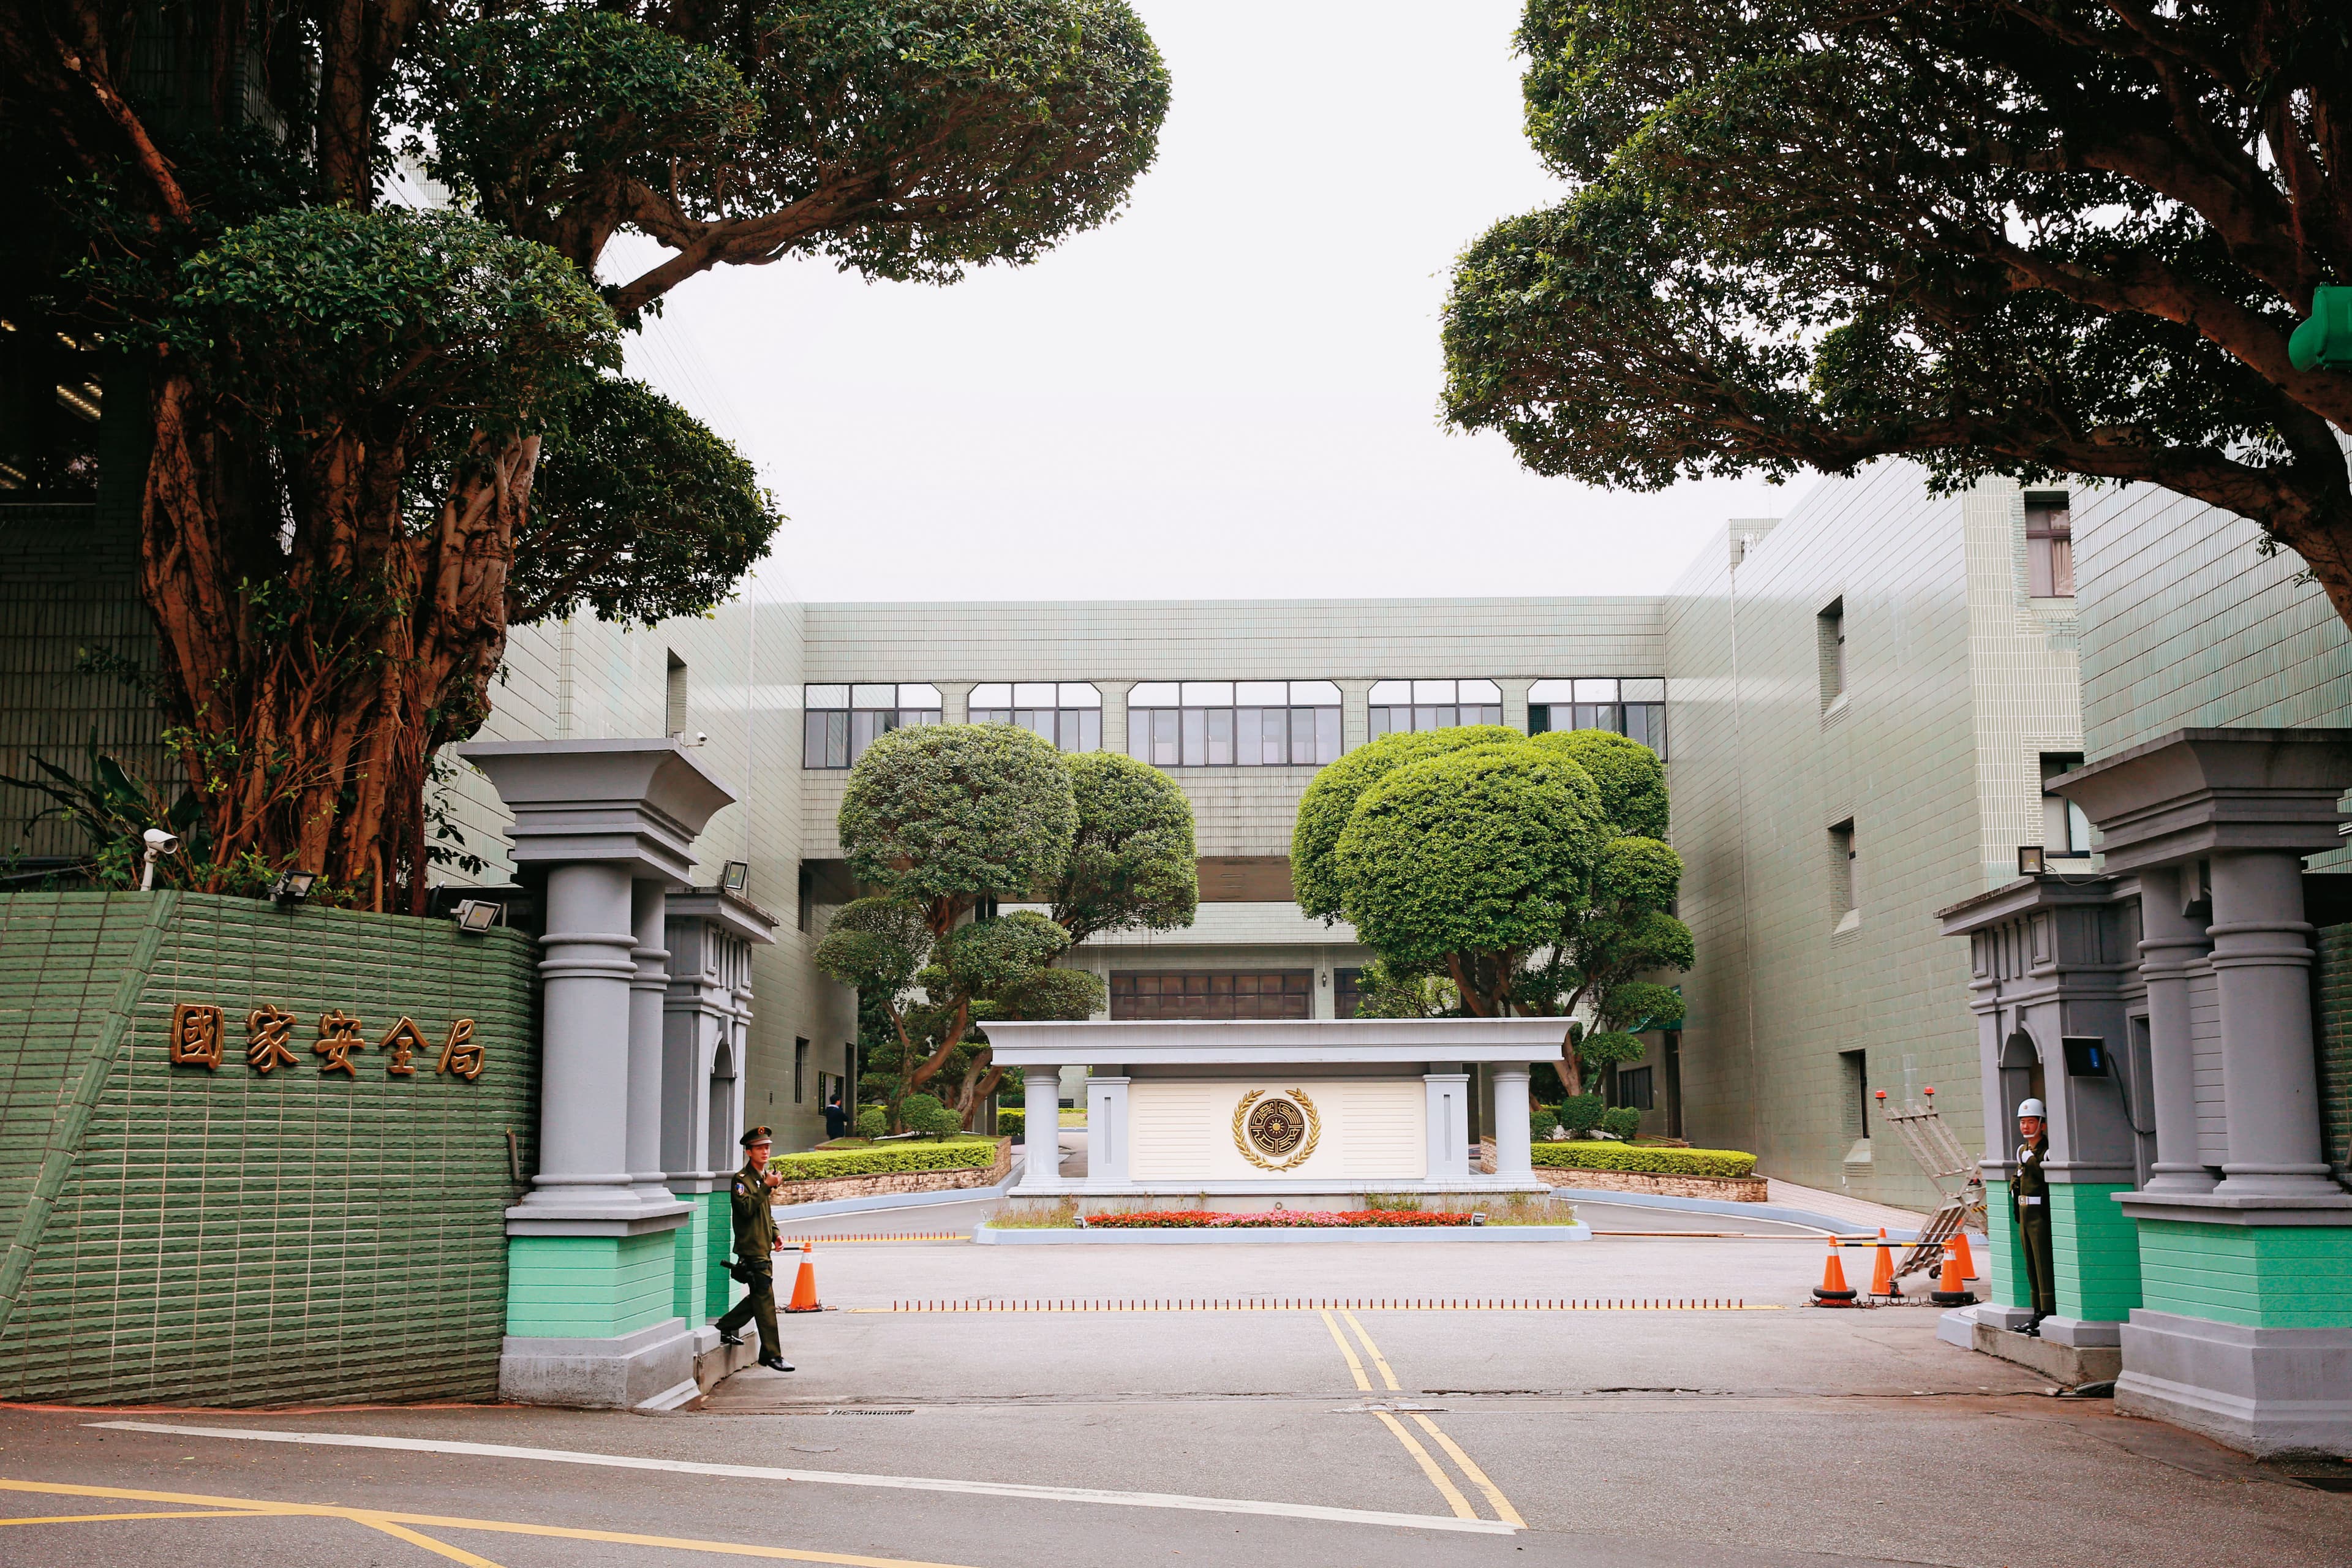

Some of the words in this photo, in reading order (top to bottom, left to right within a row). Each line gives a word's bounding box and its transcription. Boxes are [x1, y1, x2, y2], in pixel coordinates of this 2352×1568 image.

[171, 1003, 485, 1080] 國家安全局
